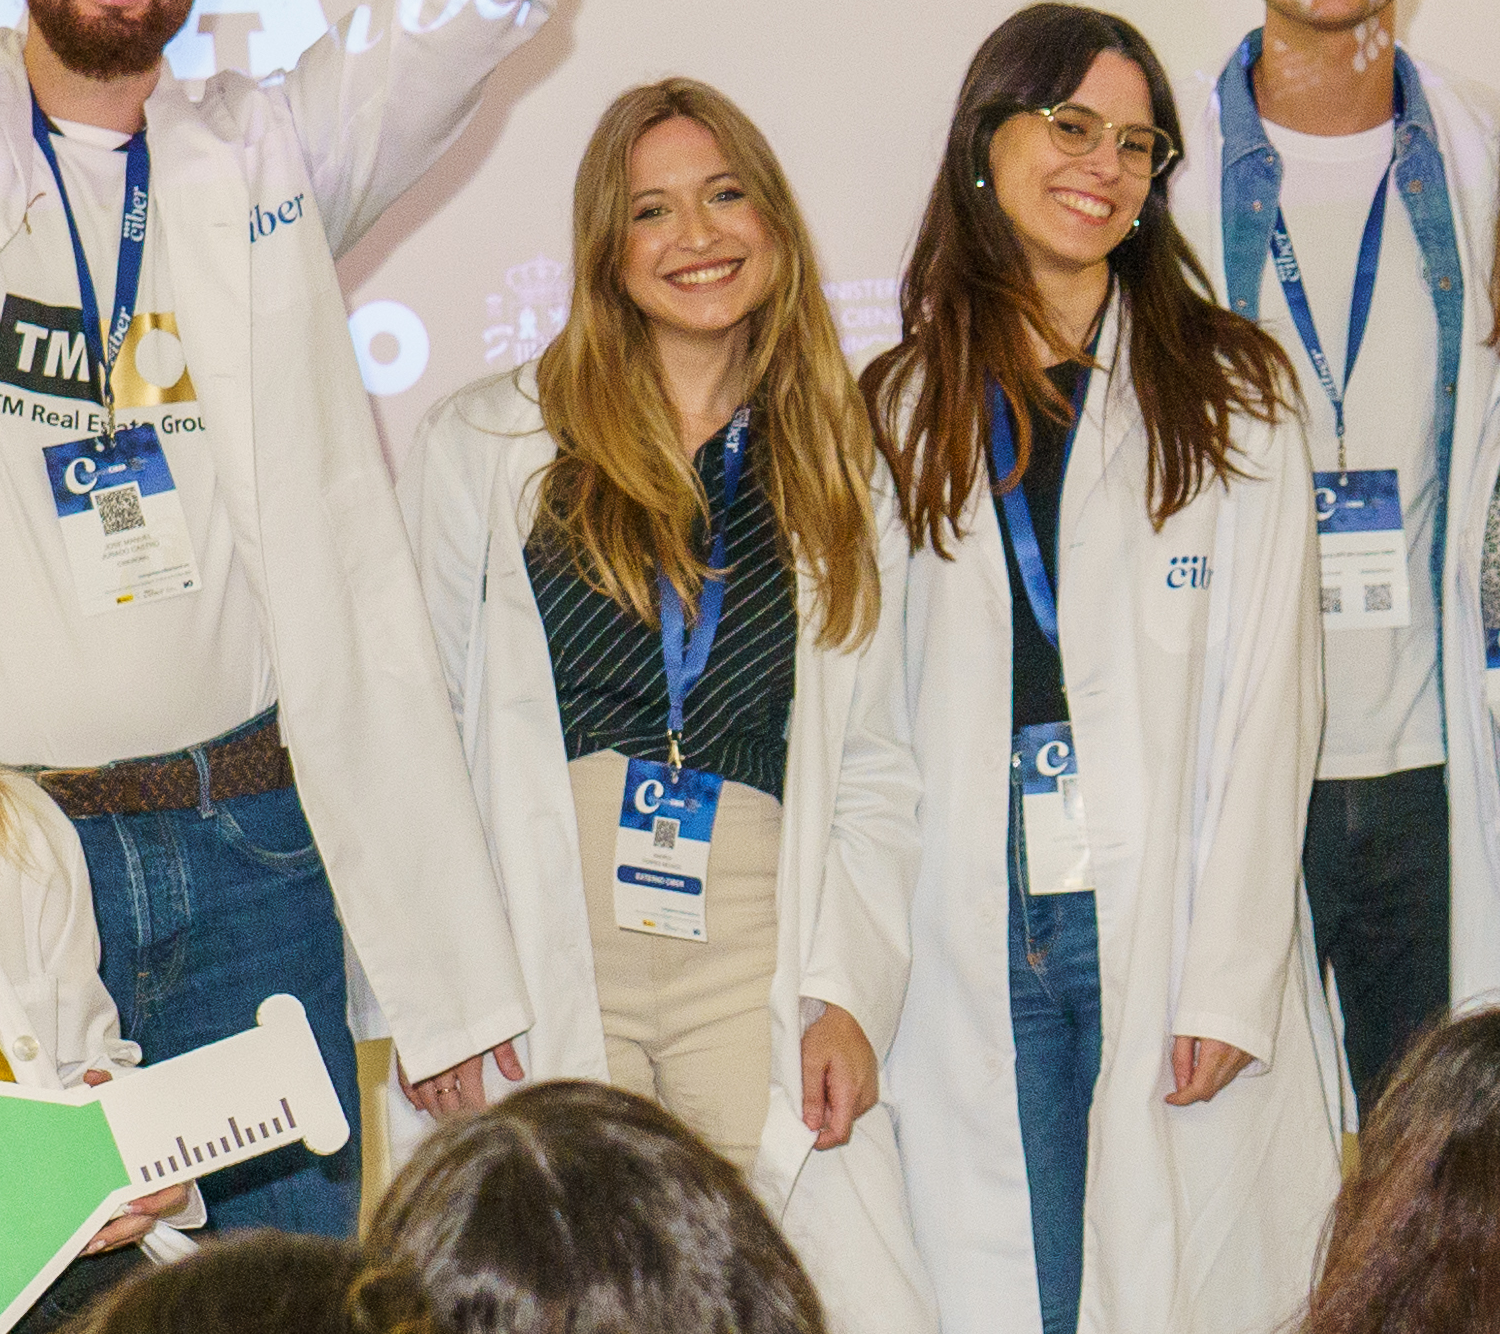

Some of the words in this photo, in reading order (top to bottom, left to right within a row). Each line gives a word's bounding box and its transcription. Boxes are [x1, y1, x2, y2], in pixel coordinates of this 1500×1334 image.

[122, 185, 150, 242] ciber
[249, 193, 304, 244] iber
[15, 321, 90, 382] TM
[32, 404, 79, 430] Real
